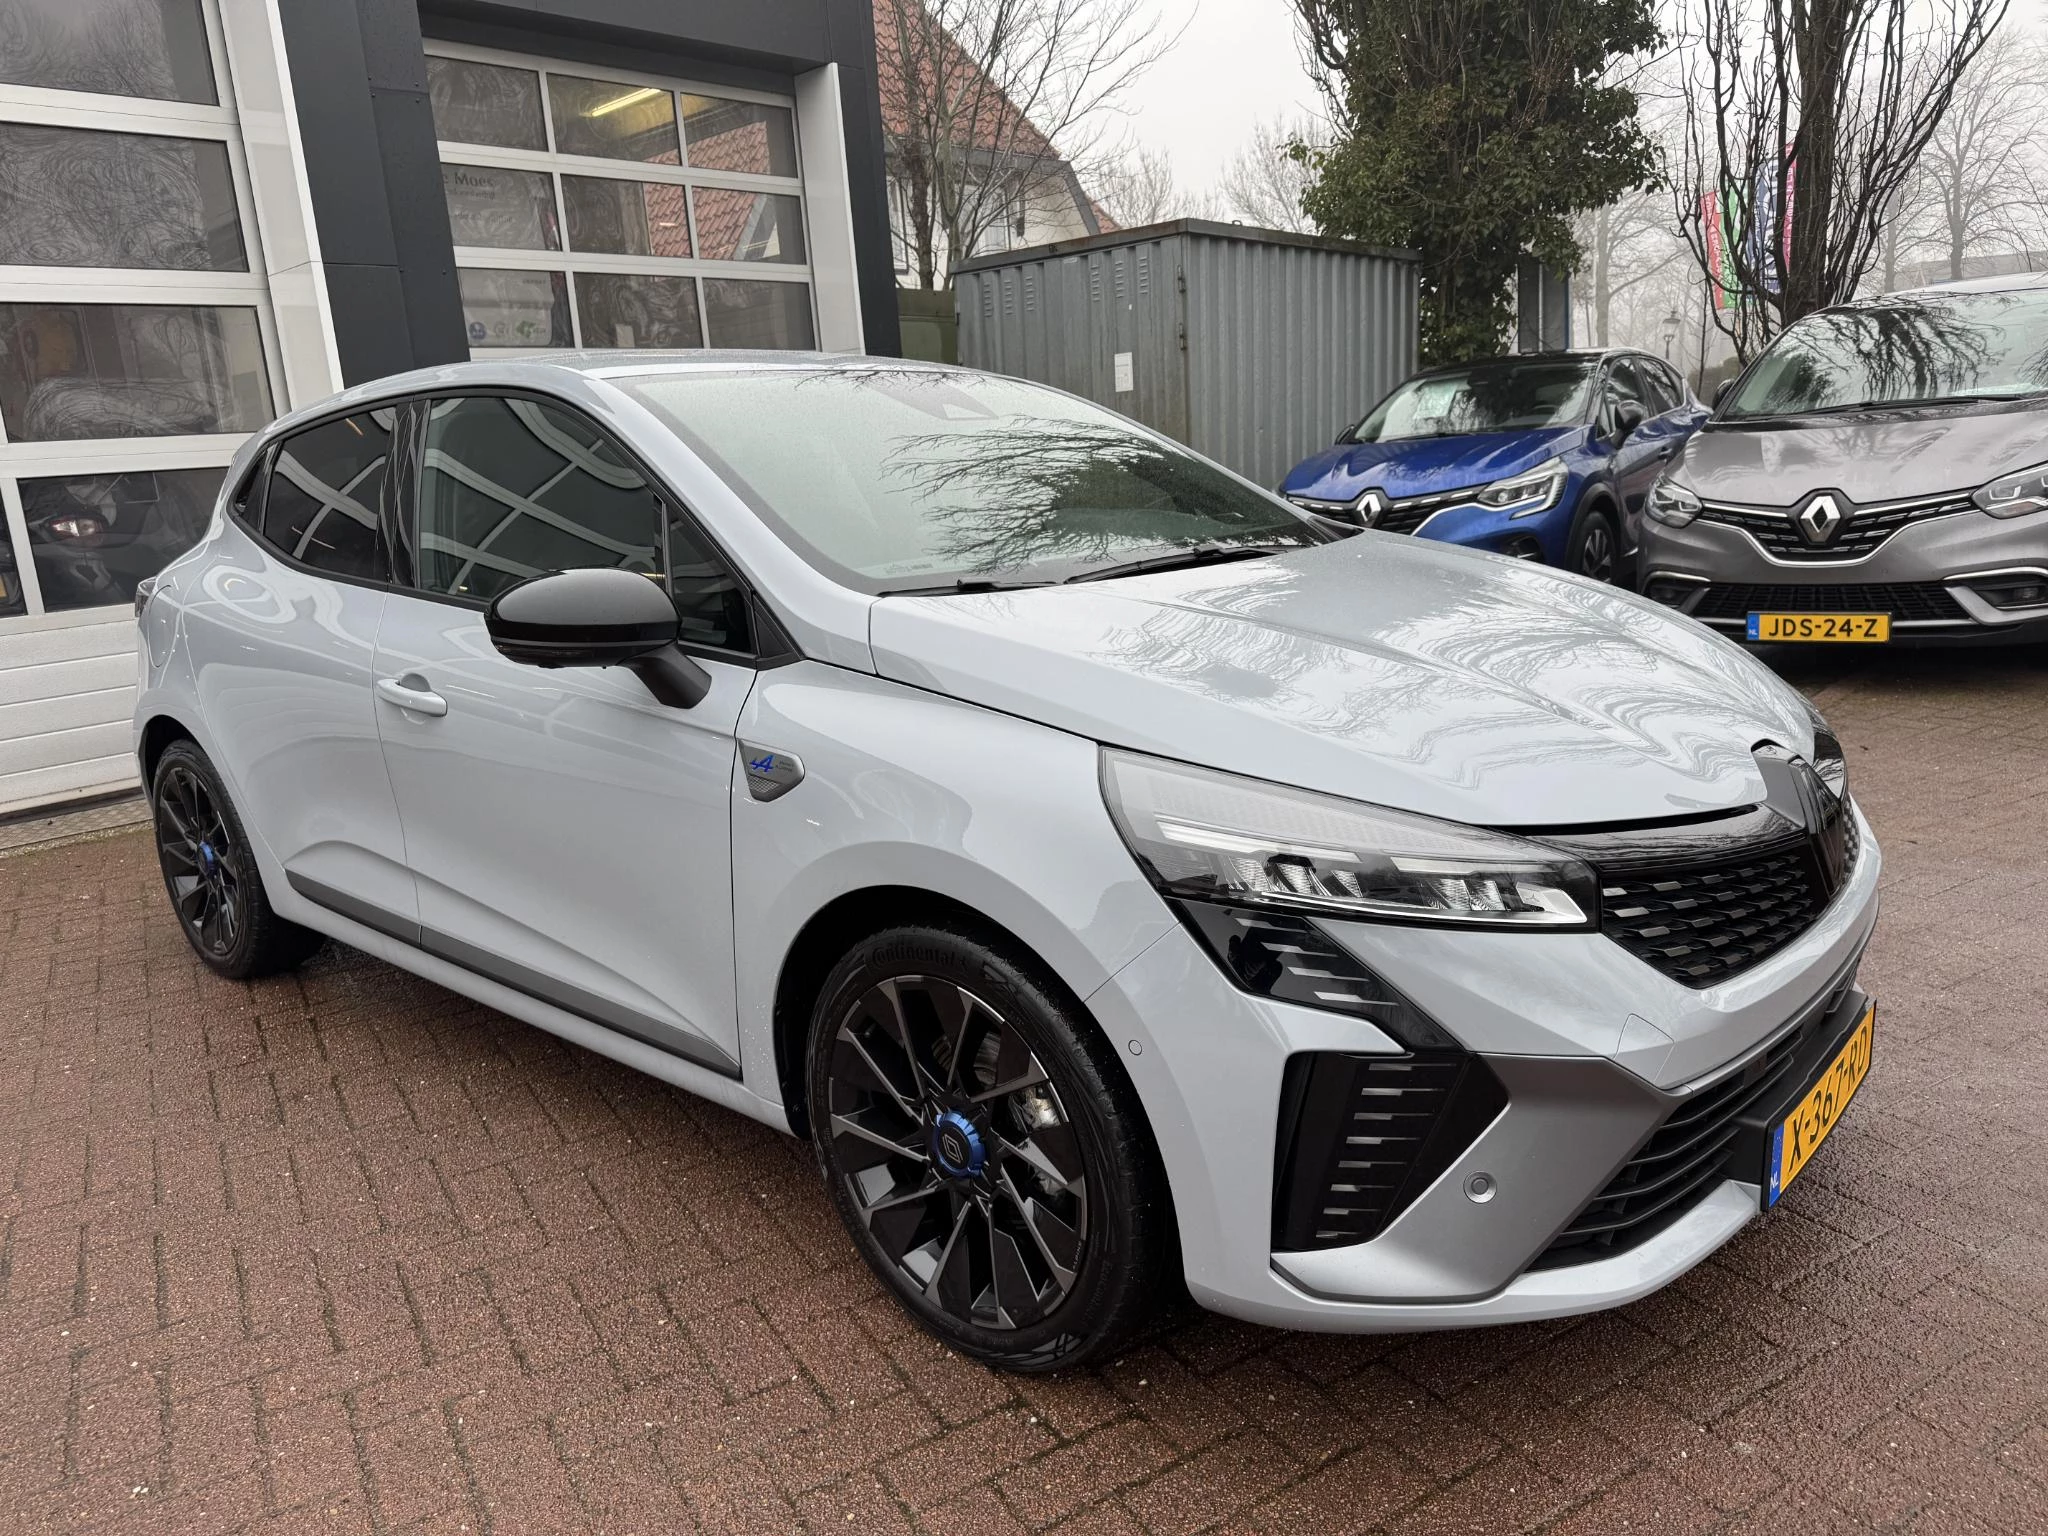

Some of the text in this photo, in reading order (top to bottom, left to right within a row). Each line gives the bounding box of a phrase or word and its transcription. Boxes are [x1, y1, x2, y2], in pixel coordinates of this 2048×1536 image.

[1748, 628, 1758, 636] NL
[1768, 618, 1878, 638] JDS-24-Z
[1788, 1025, 1868, 1173] X-367-RD
[1769, 1171, 1779, 1192] NL
